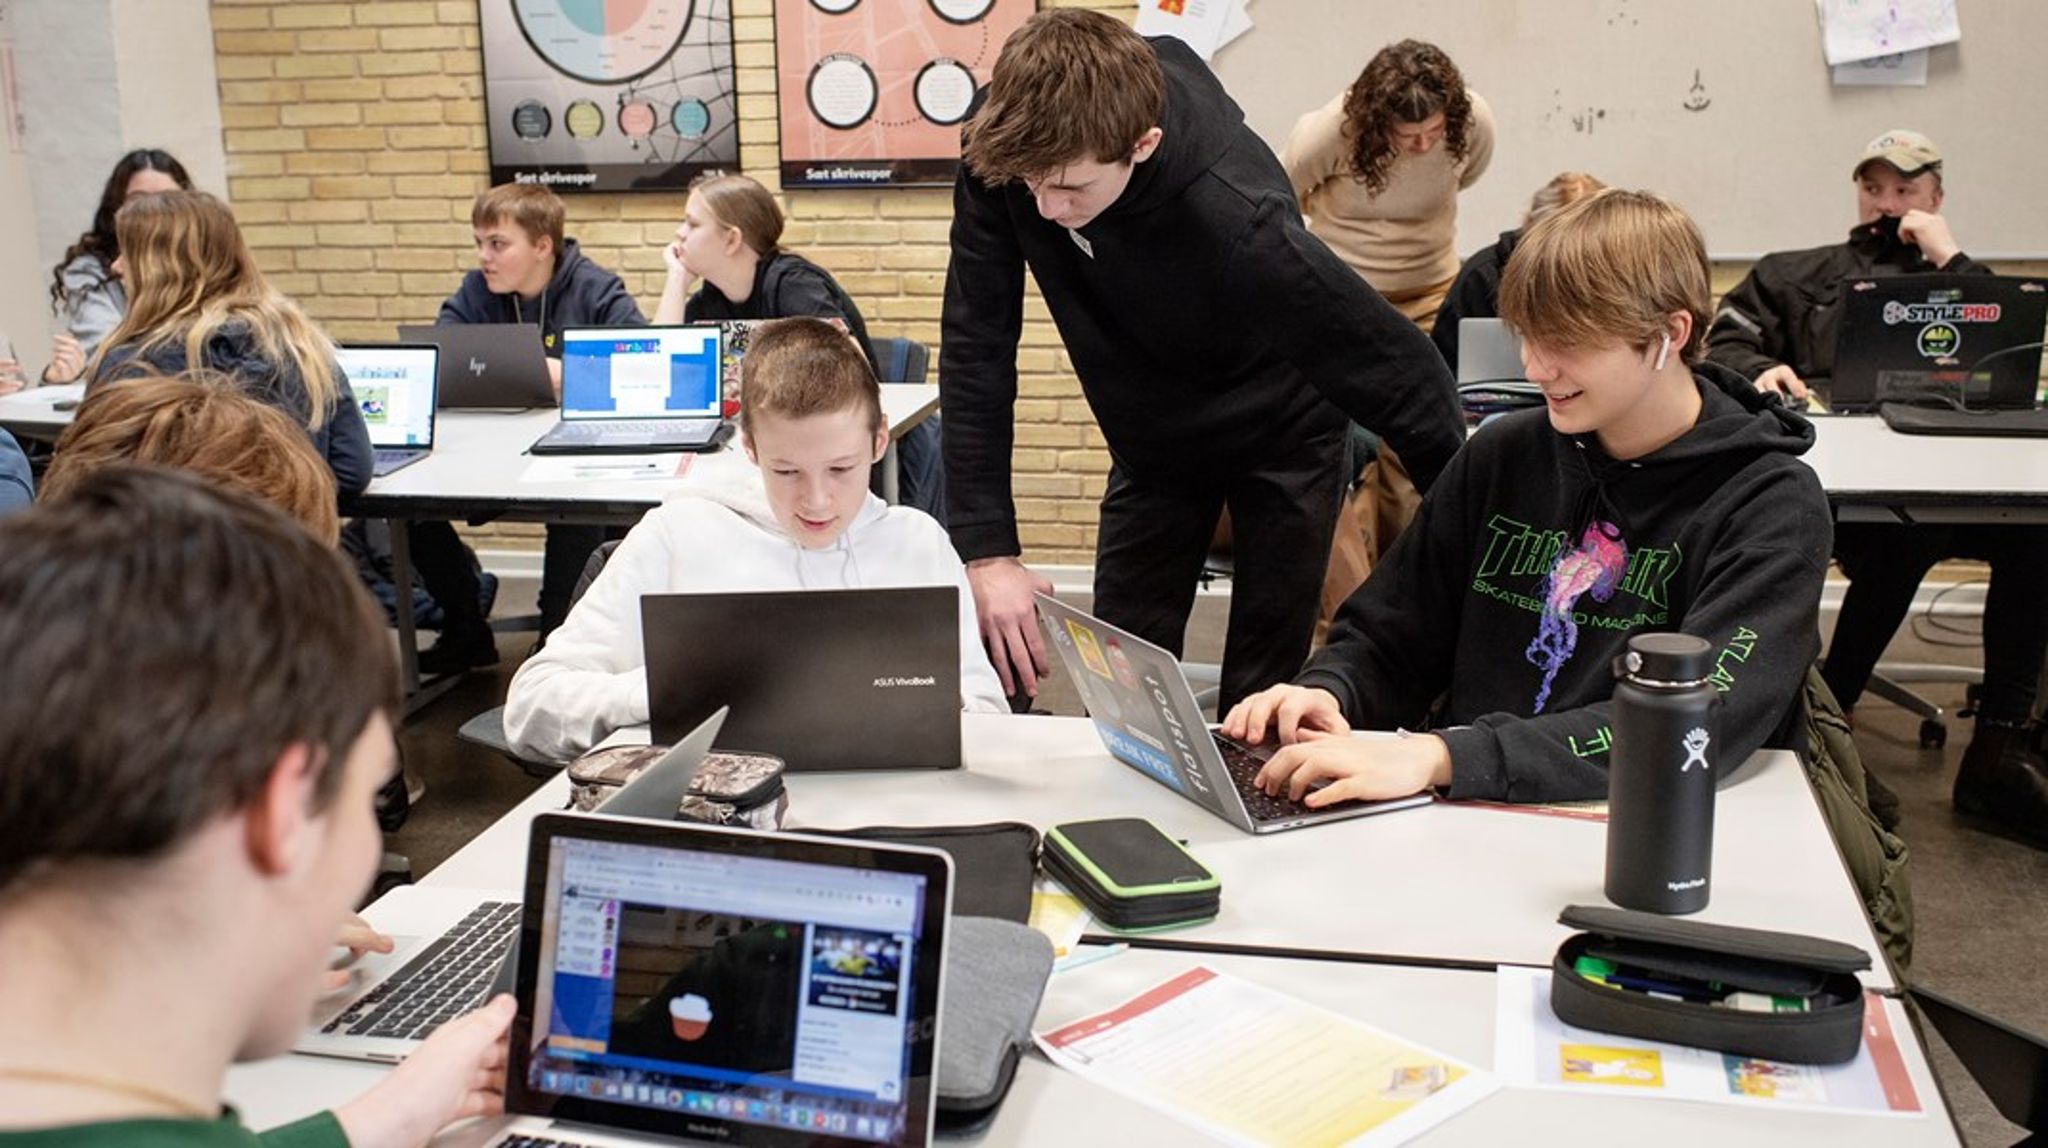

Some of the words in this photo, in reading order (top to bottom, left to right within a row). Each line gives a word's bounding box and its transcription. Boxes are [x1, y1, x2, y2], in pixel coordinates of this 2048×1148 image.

[831, 167, 892, 182] skrivespor
[1906, 304, 2000, 322] STYLEPRO
[896, 676, 935, 686] VivoBook
